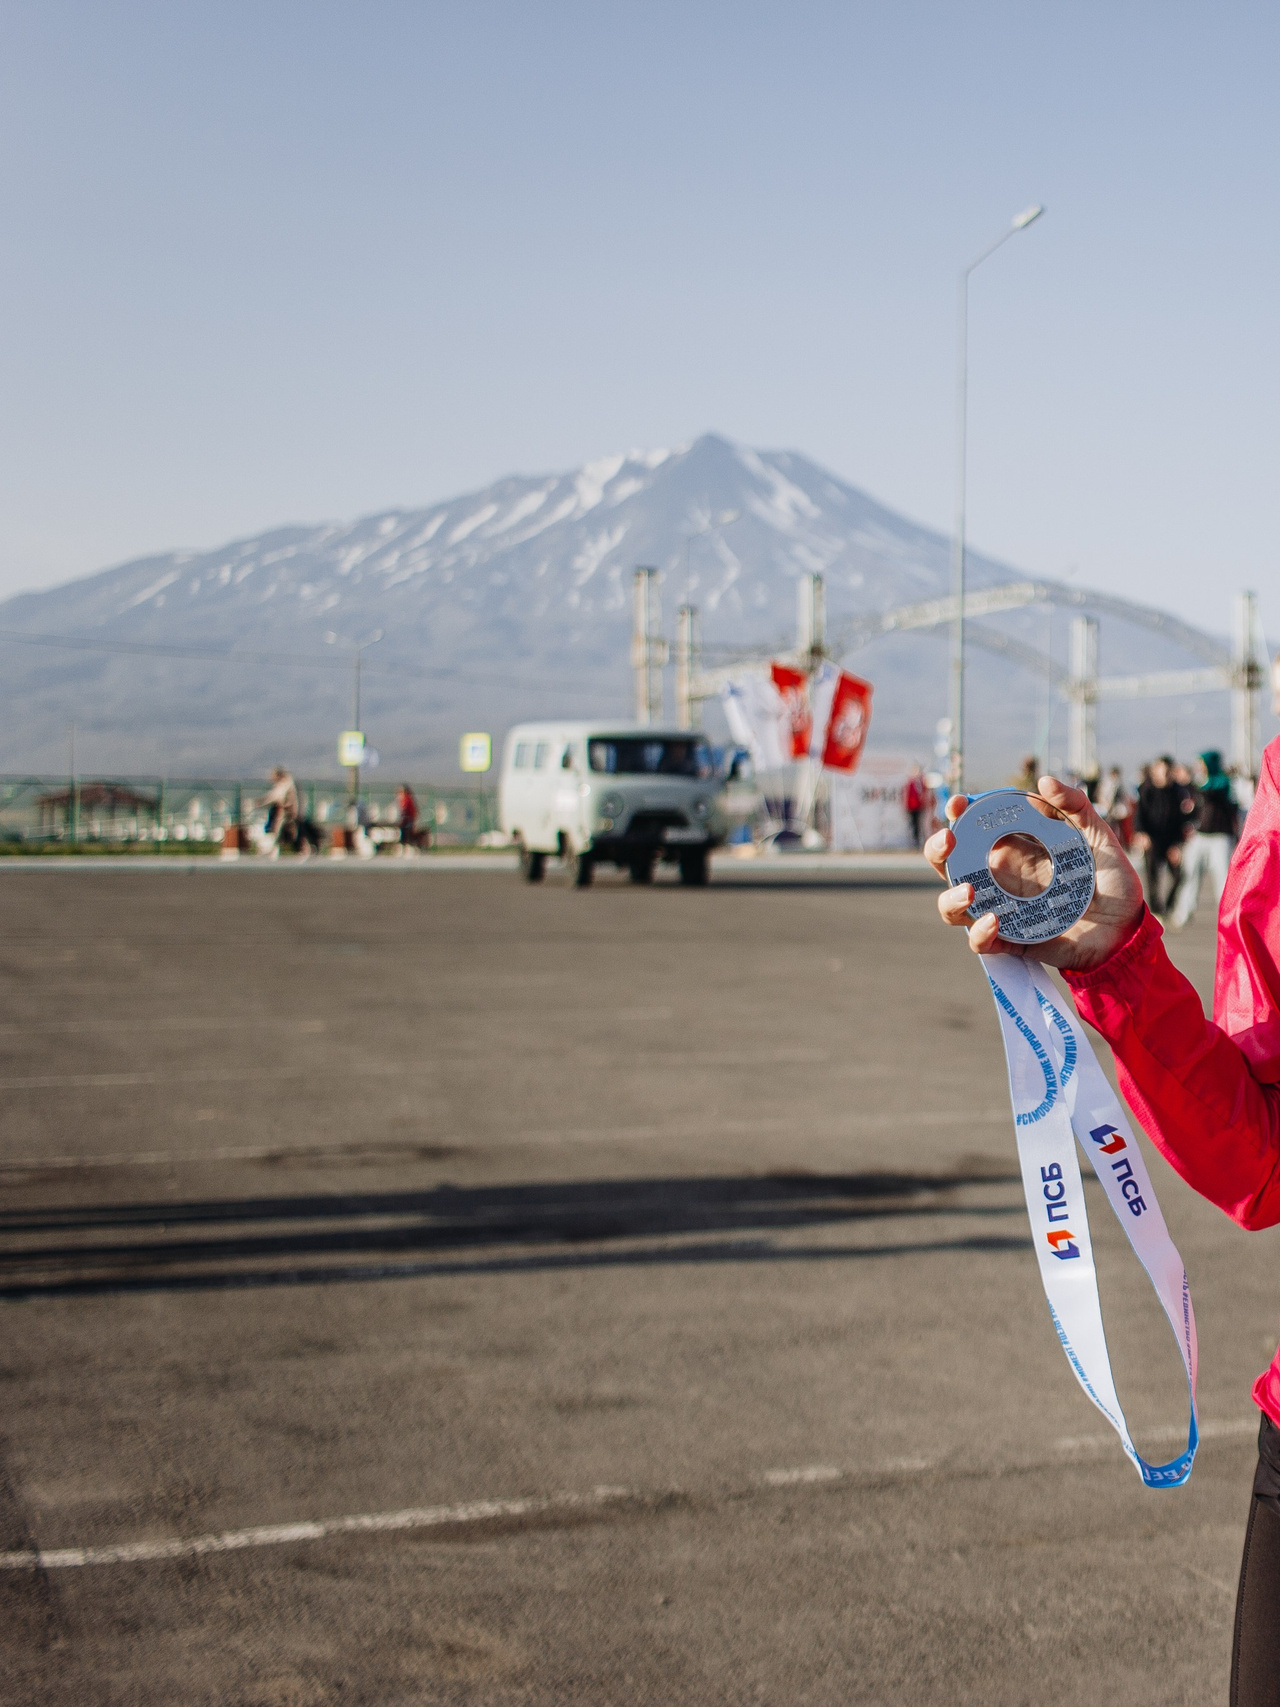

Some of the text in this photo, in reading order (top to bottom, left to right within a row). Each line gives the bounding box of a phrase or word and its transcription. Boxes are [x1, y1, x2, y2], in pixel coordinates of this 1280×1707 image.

[1053, 846, 1084, 863] ОРДОСТЬ
[999, 910, 1020, 925] ДОСТЬ
[999, 922, 1017, 933] ЕЧТА
[1043, 1004, 1073, 1034] #ТРЕПЕТ
[1015, 1016, 1047, 1059] #ГОРДОСТЬ
[1040, 1162, 1069, 1223] ПСБ
[1111, 1157, 1148, 1217] ПСБ
